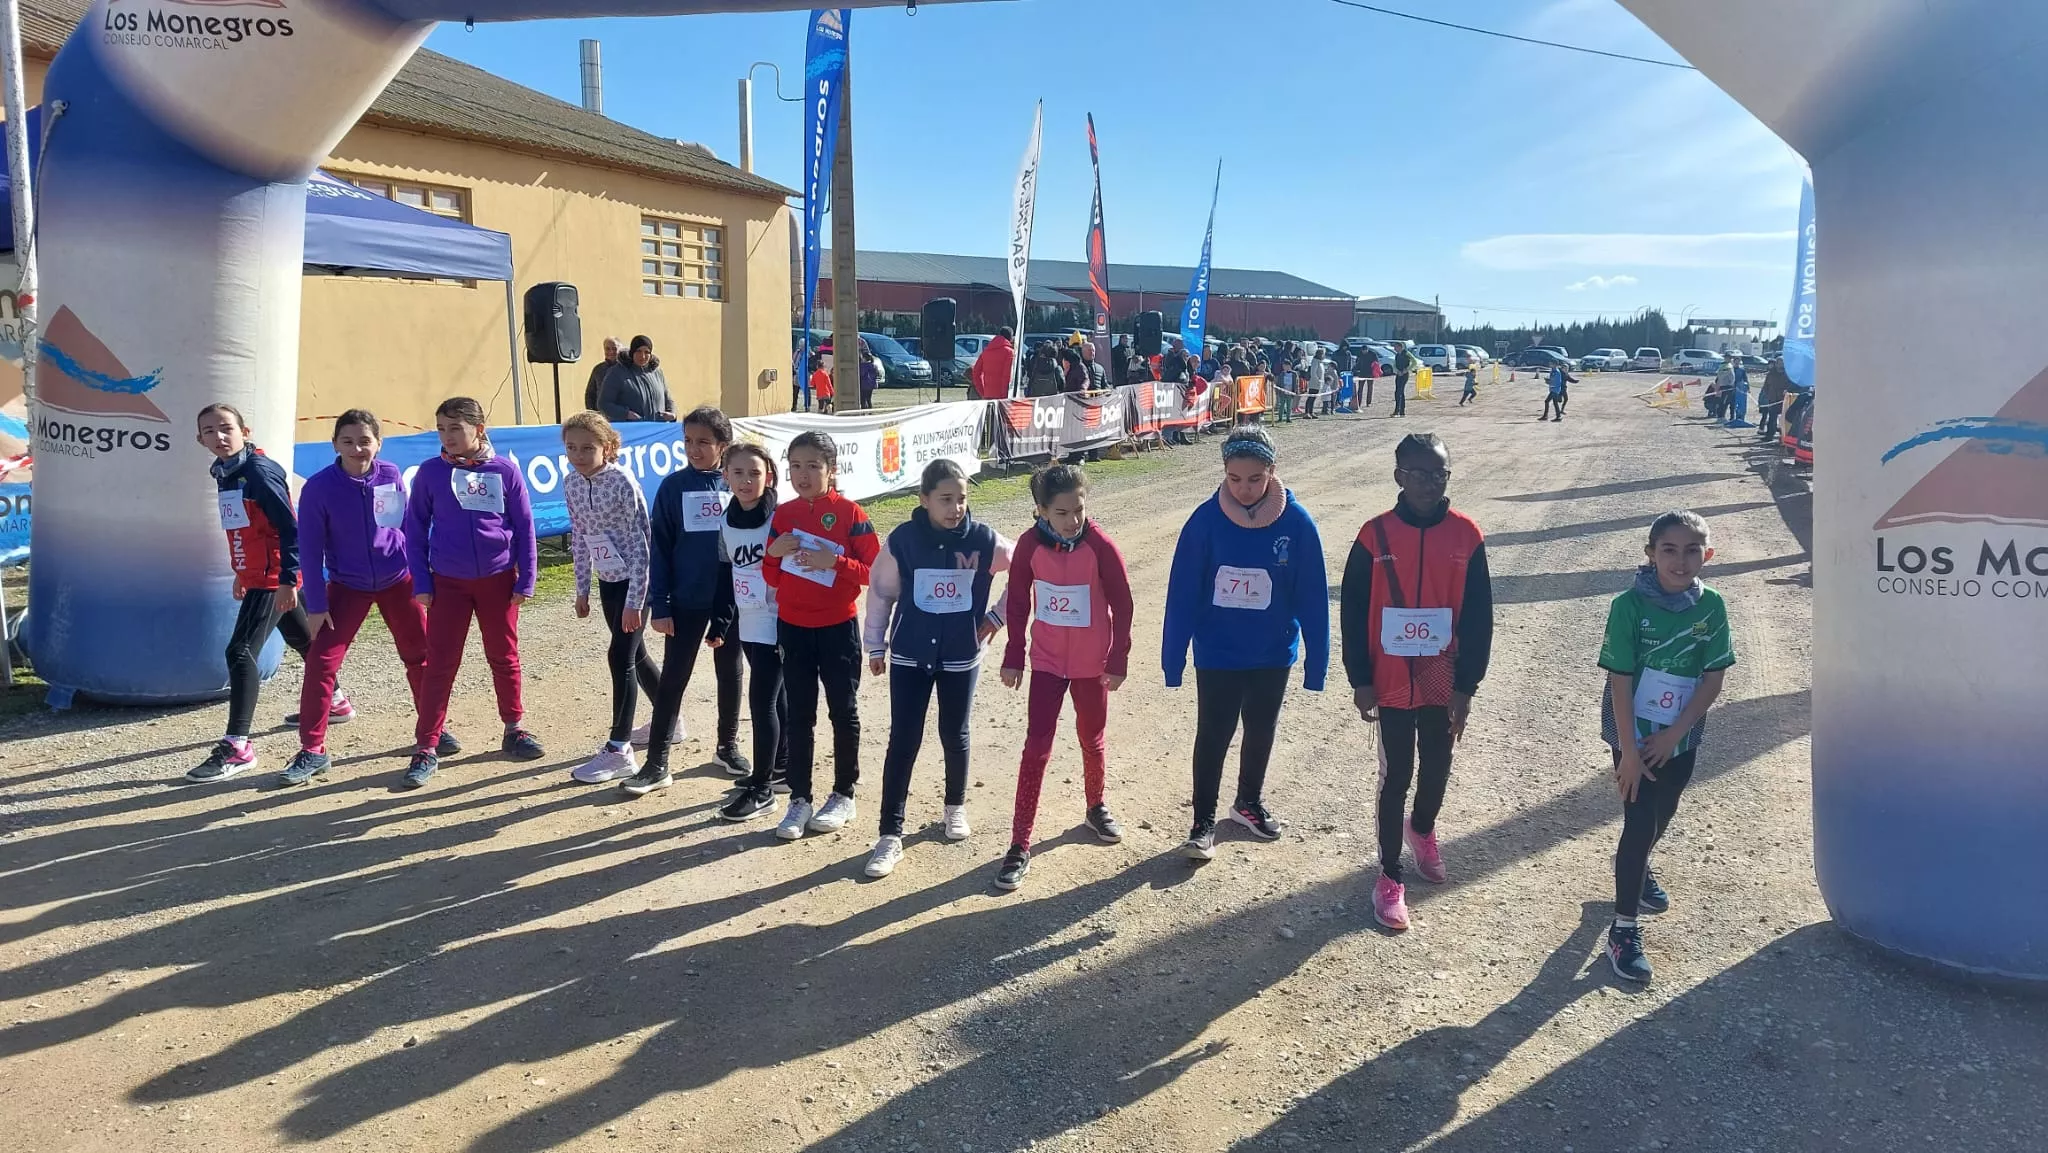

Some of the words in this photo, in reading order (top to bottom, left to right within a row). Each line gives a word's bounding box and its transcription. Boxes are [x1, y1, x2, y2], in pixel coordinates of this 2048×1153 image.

[104, 8, 138, 32] Los
[147, 8, 294, 43] Monegros
[103, 32, 151, 46] CONSEJO
[154, 34, 229, 50] COMARCAL
[37, 415, 171, 453] Monegros
[916, 449, 928, 463] DE
[467, 480, 488, 496] 88
[222, 503, 233, 518] 76
[701, 502, 722, 517] 59
[592, 545, 612, 560] 72
[954, 550, 980, 572] M
[1876, 537, 1955, 575] Los
[734, 578, 750, 596] 65
[934, 582, 956, 598] 69
[1229, 579, 1250, 595] 71
[1877, 576, 1981, 597] CONSEJO
[1049, 595, 1070, 612] 82
[1404, 622, 1430, 640] 96
